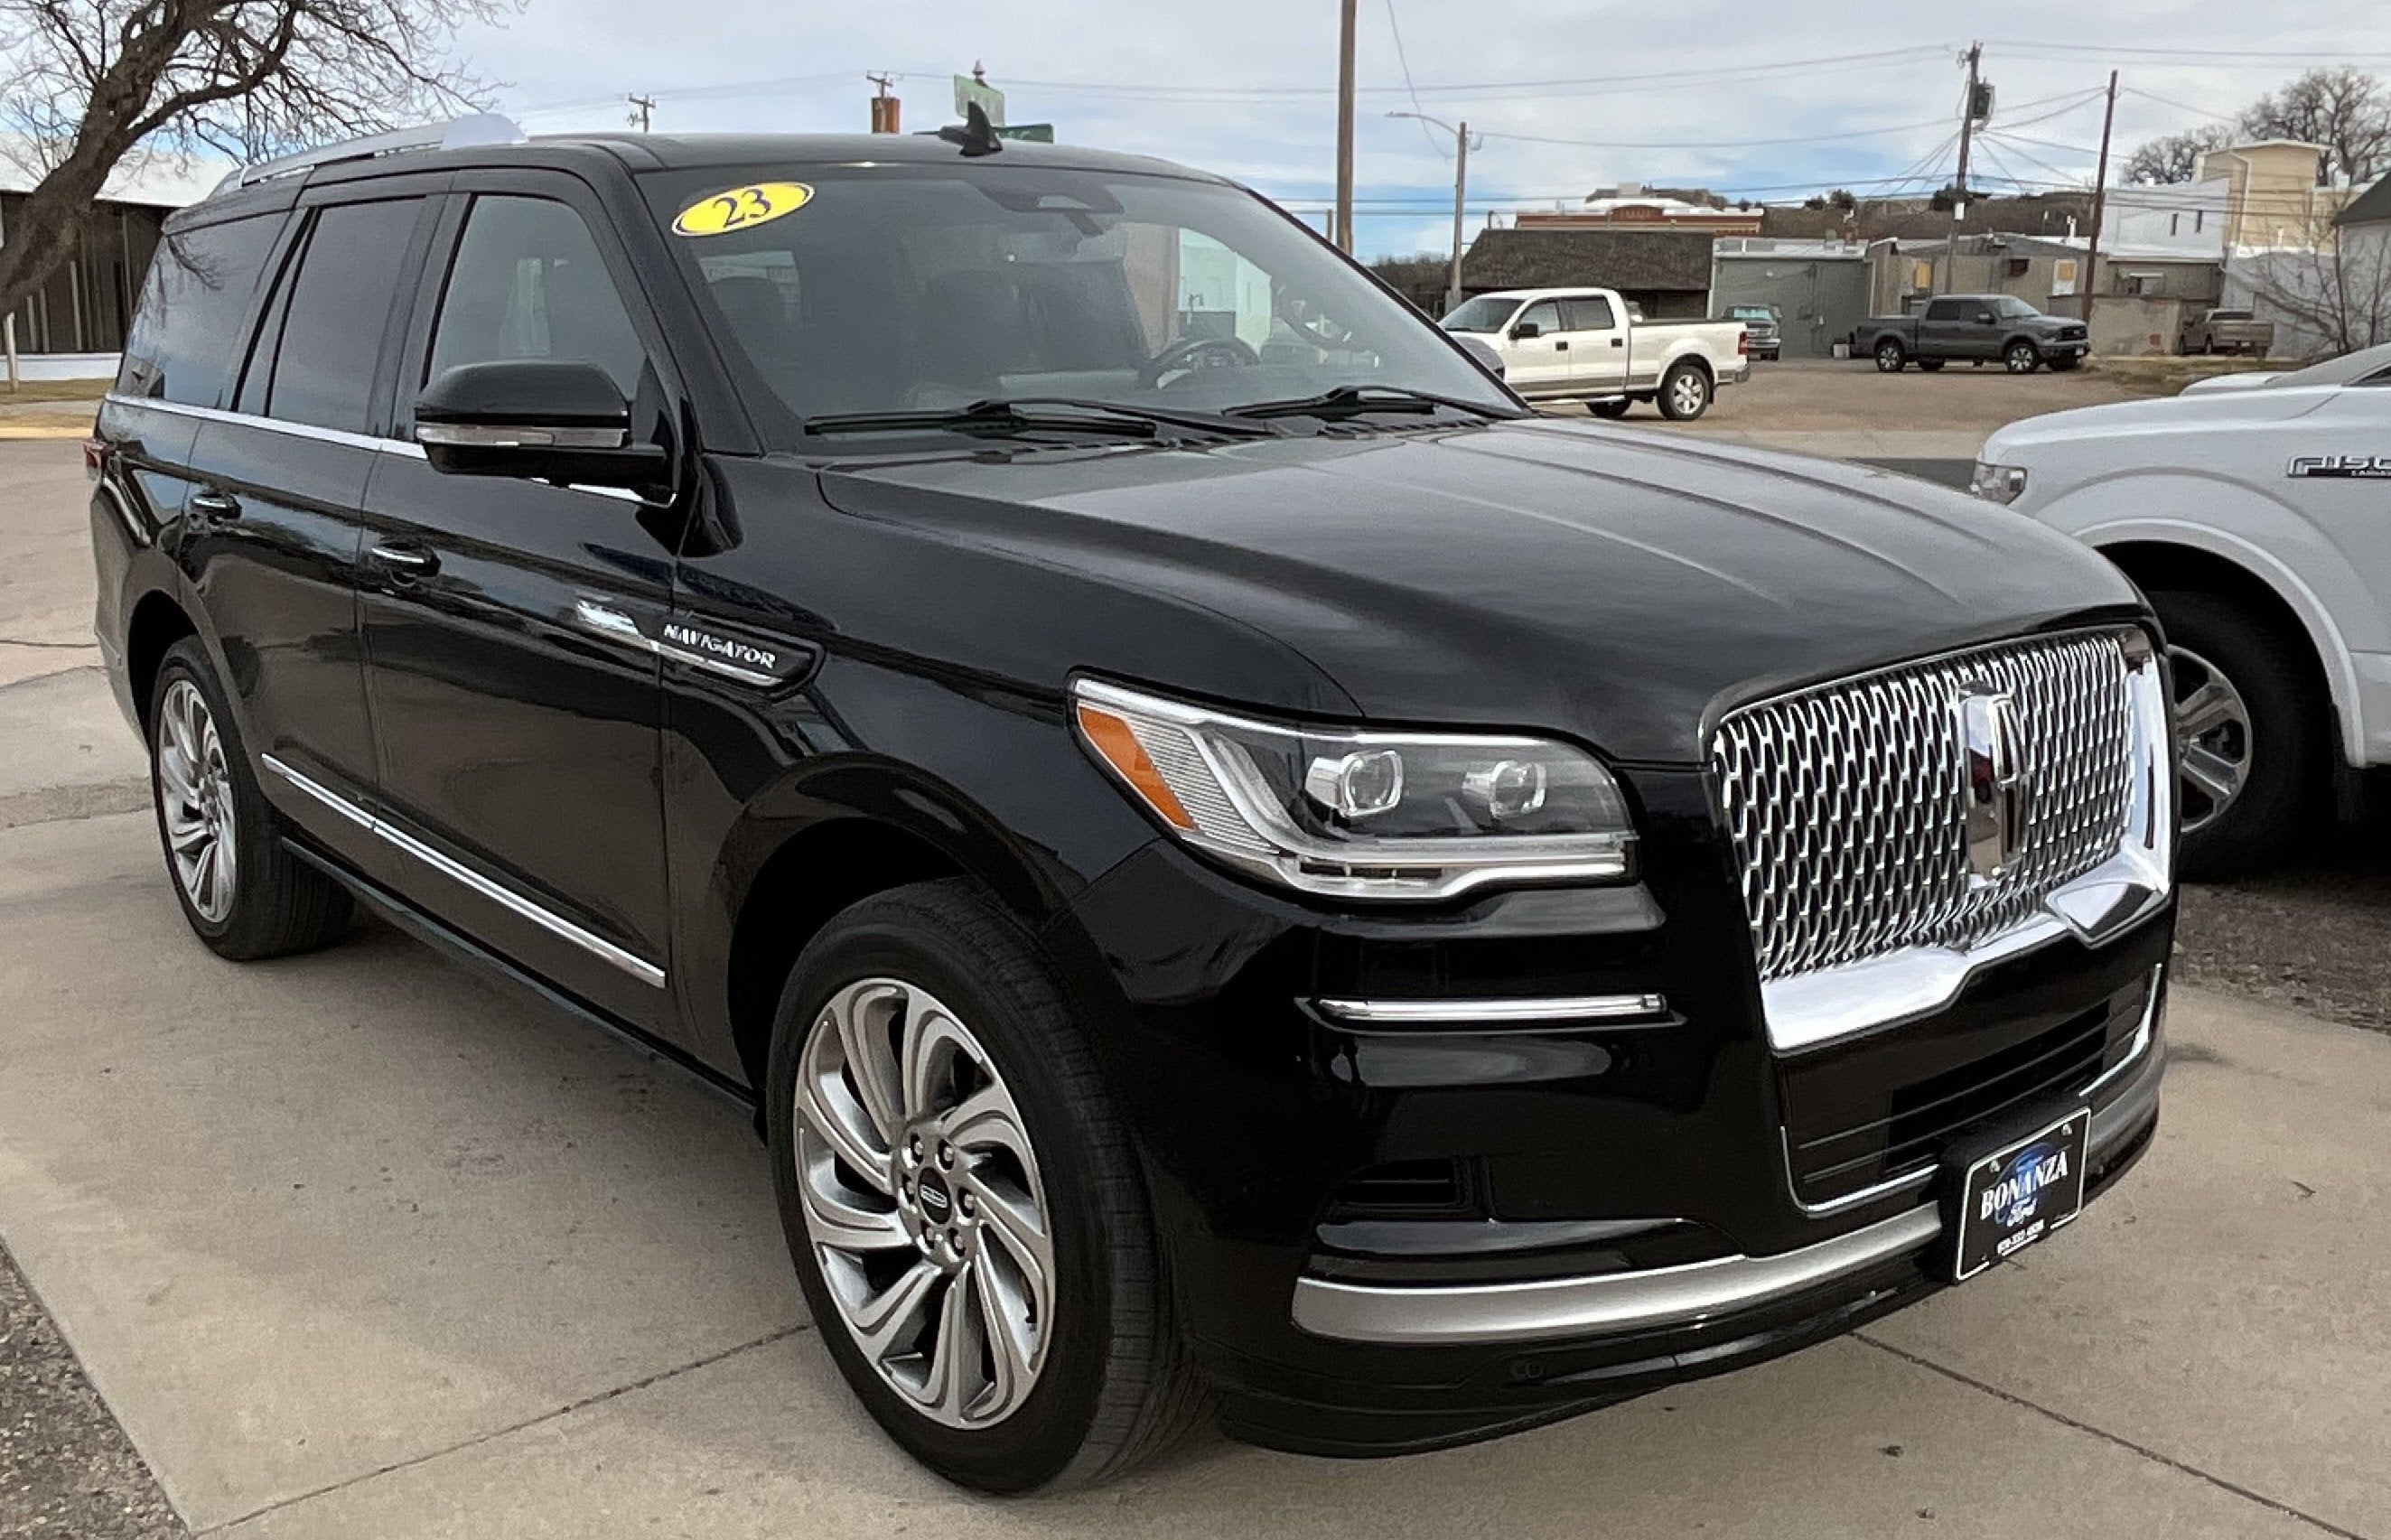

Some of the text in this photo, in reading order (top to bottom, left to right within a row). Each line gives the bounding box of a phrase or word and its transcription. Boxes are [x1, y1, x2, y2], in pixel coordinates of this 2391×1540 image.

[712, 188, 772, 229] 23
[664, 623, 776, 669] NAVIGATOR
[1980, 1150, 2069, 1220] BONANZA
